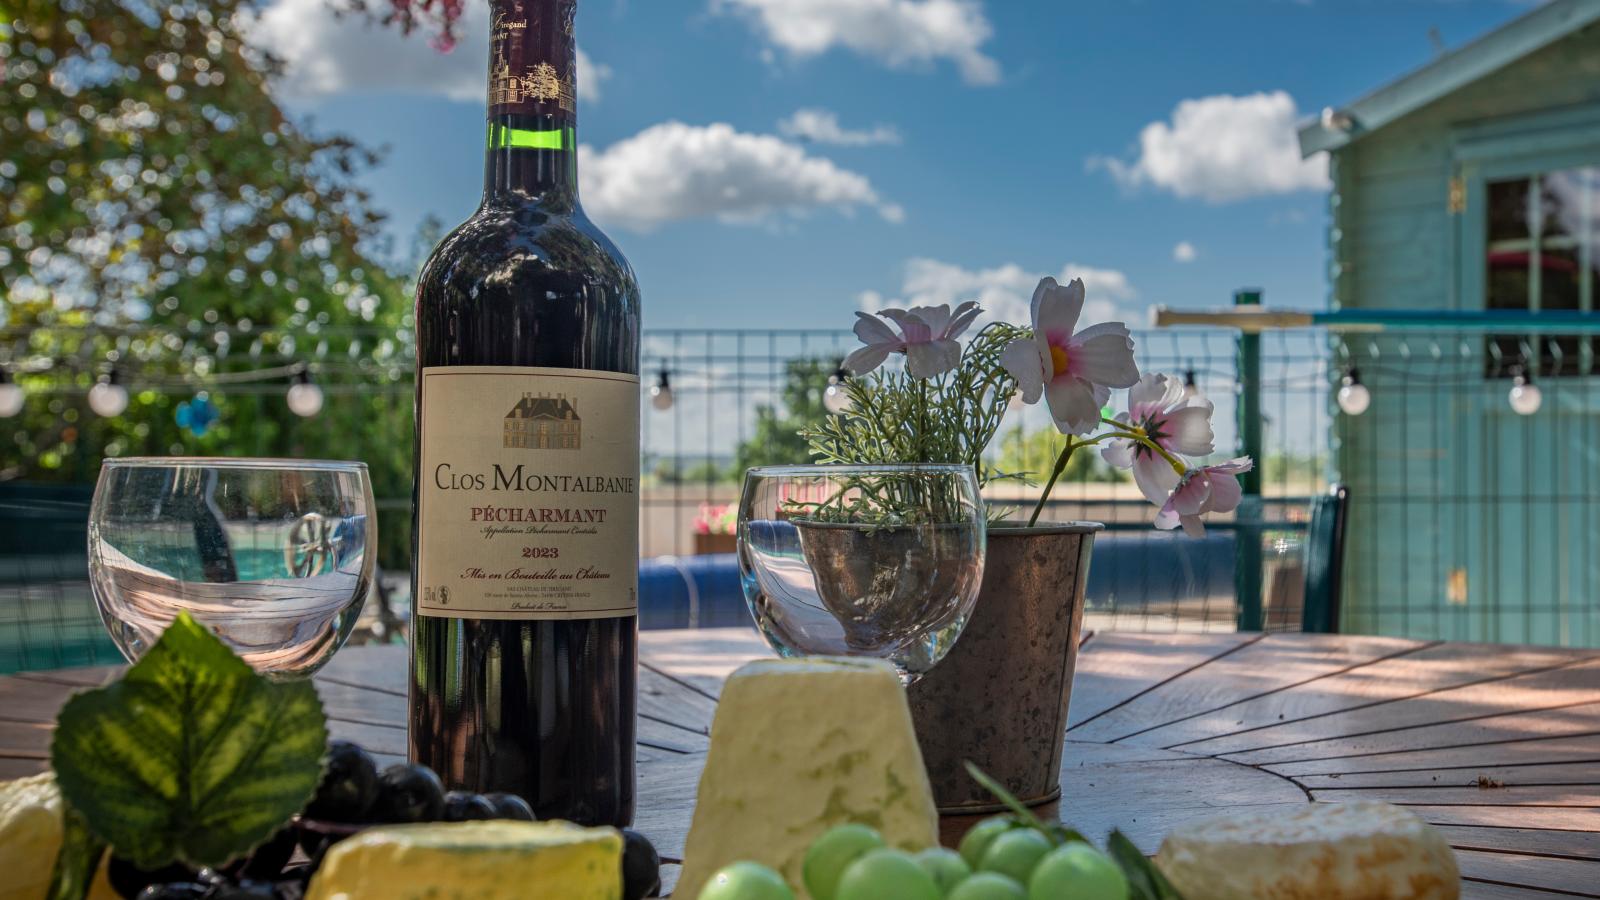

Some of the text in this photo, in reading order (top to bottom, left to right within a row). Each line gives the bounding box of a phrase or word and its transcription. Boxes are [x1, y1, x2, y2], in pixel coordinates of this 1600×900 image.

[470, 504, 607, 523] PÉCHARMANT
[480, 525, 523, 539] Appellation
[521, 547, 559, 559] 2023
[460, 567, 486, 580] Mis
[505, 567, 558, 580] Bouteille
[575, 565, 611, 580] Château
